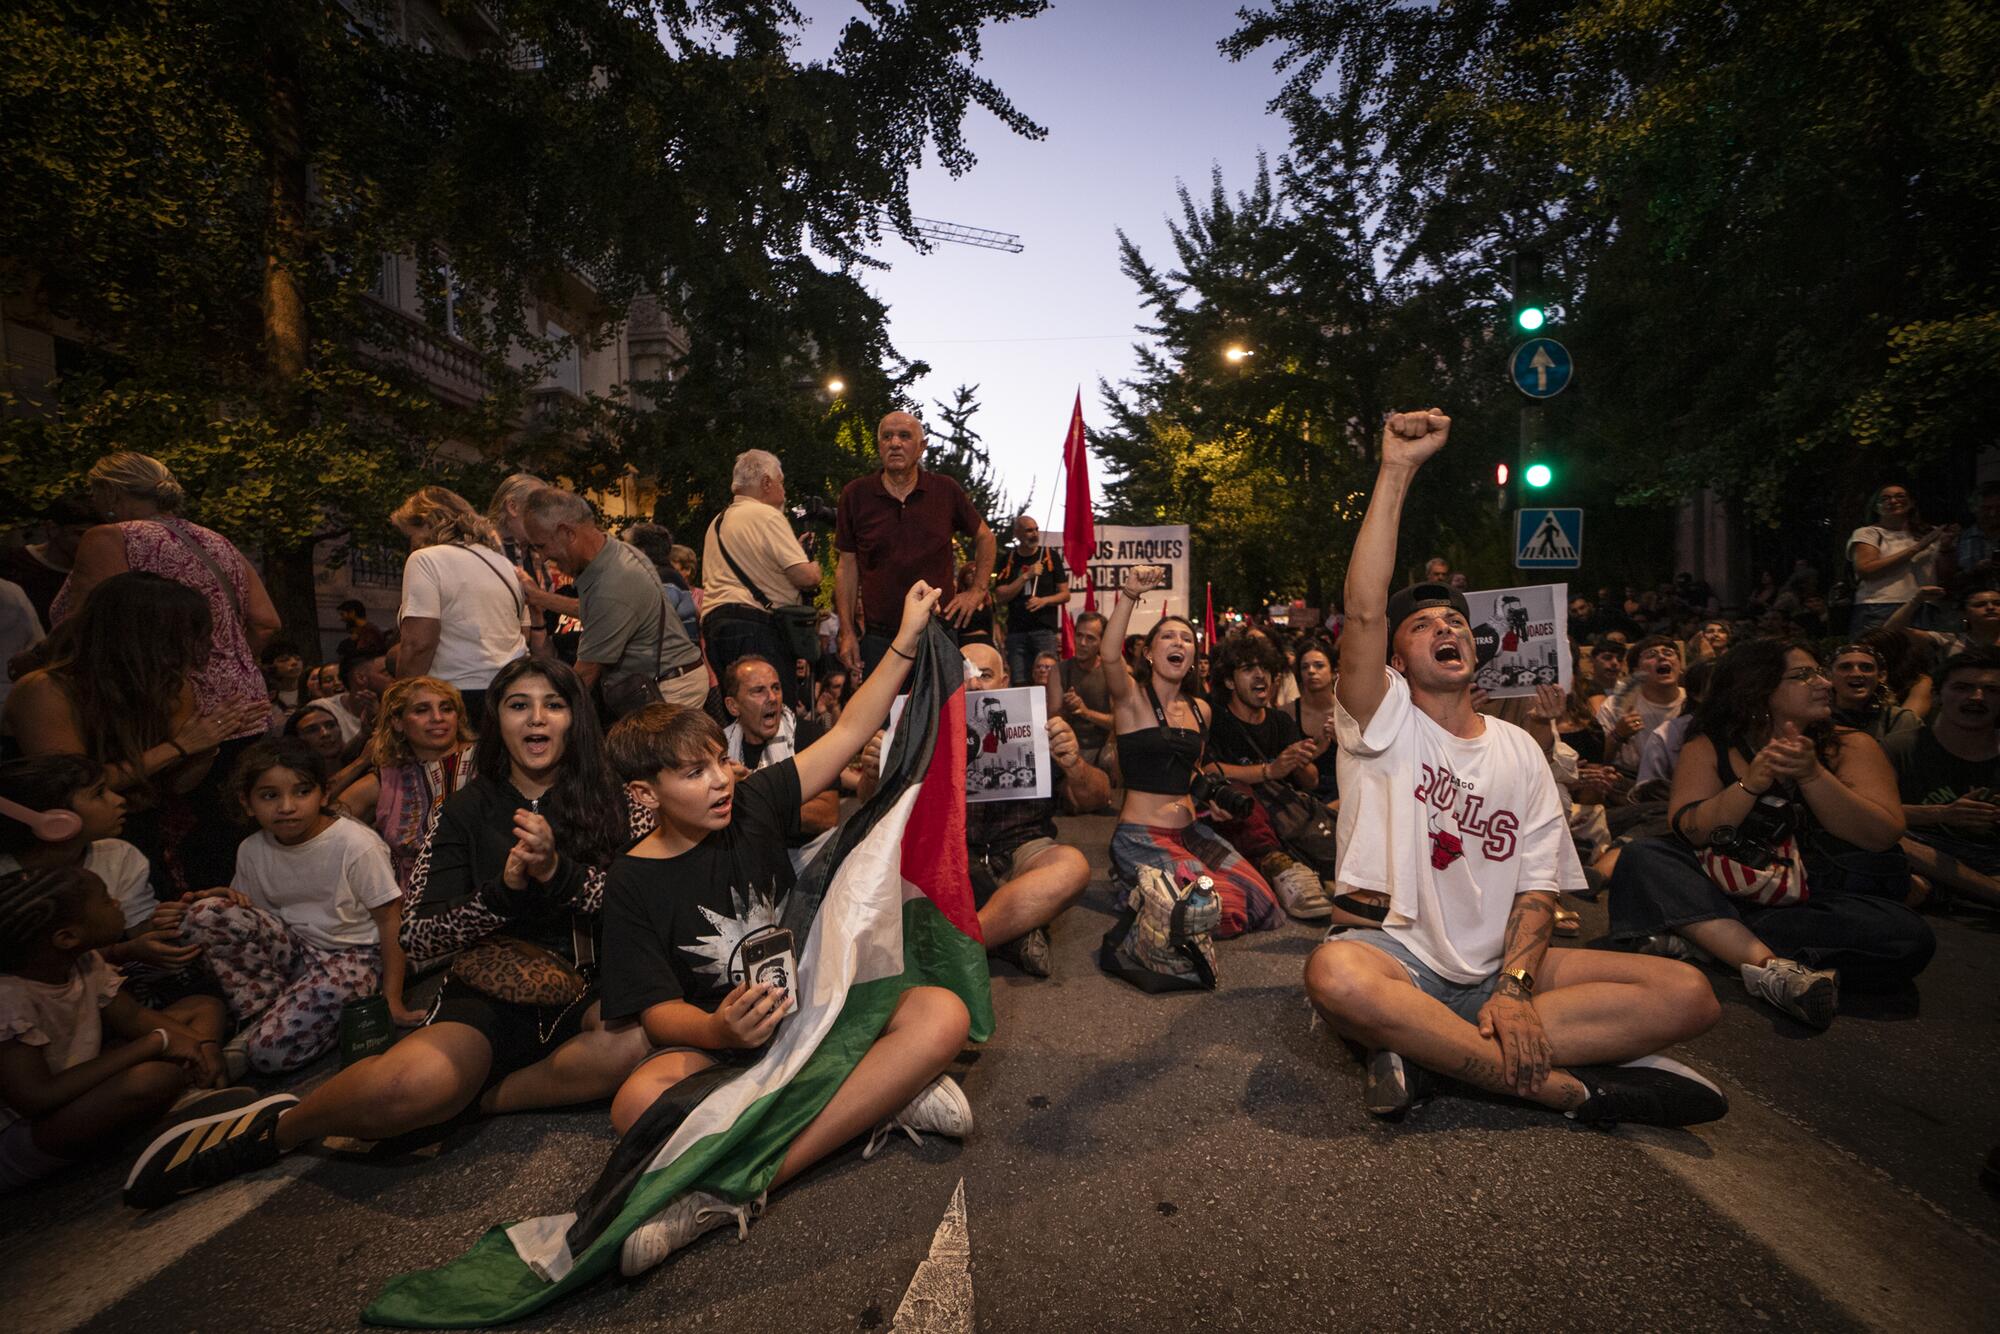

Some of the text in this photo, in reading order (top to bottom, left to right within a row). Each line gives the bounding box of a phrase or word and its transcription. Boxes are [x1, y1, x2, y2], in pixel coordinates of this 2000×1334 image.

[1117, 539, 1183, 562] ATAQUES
[1096, 566, 1115, 587] DE
[1524, 622, 1554, 638] DADES
[1473, 636, 1494, 646] TRAS
